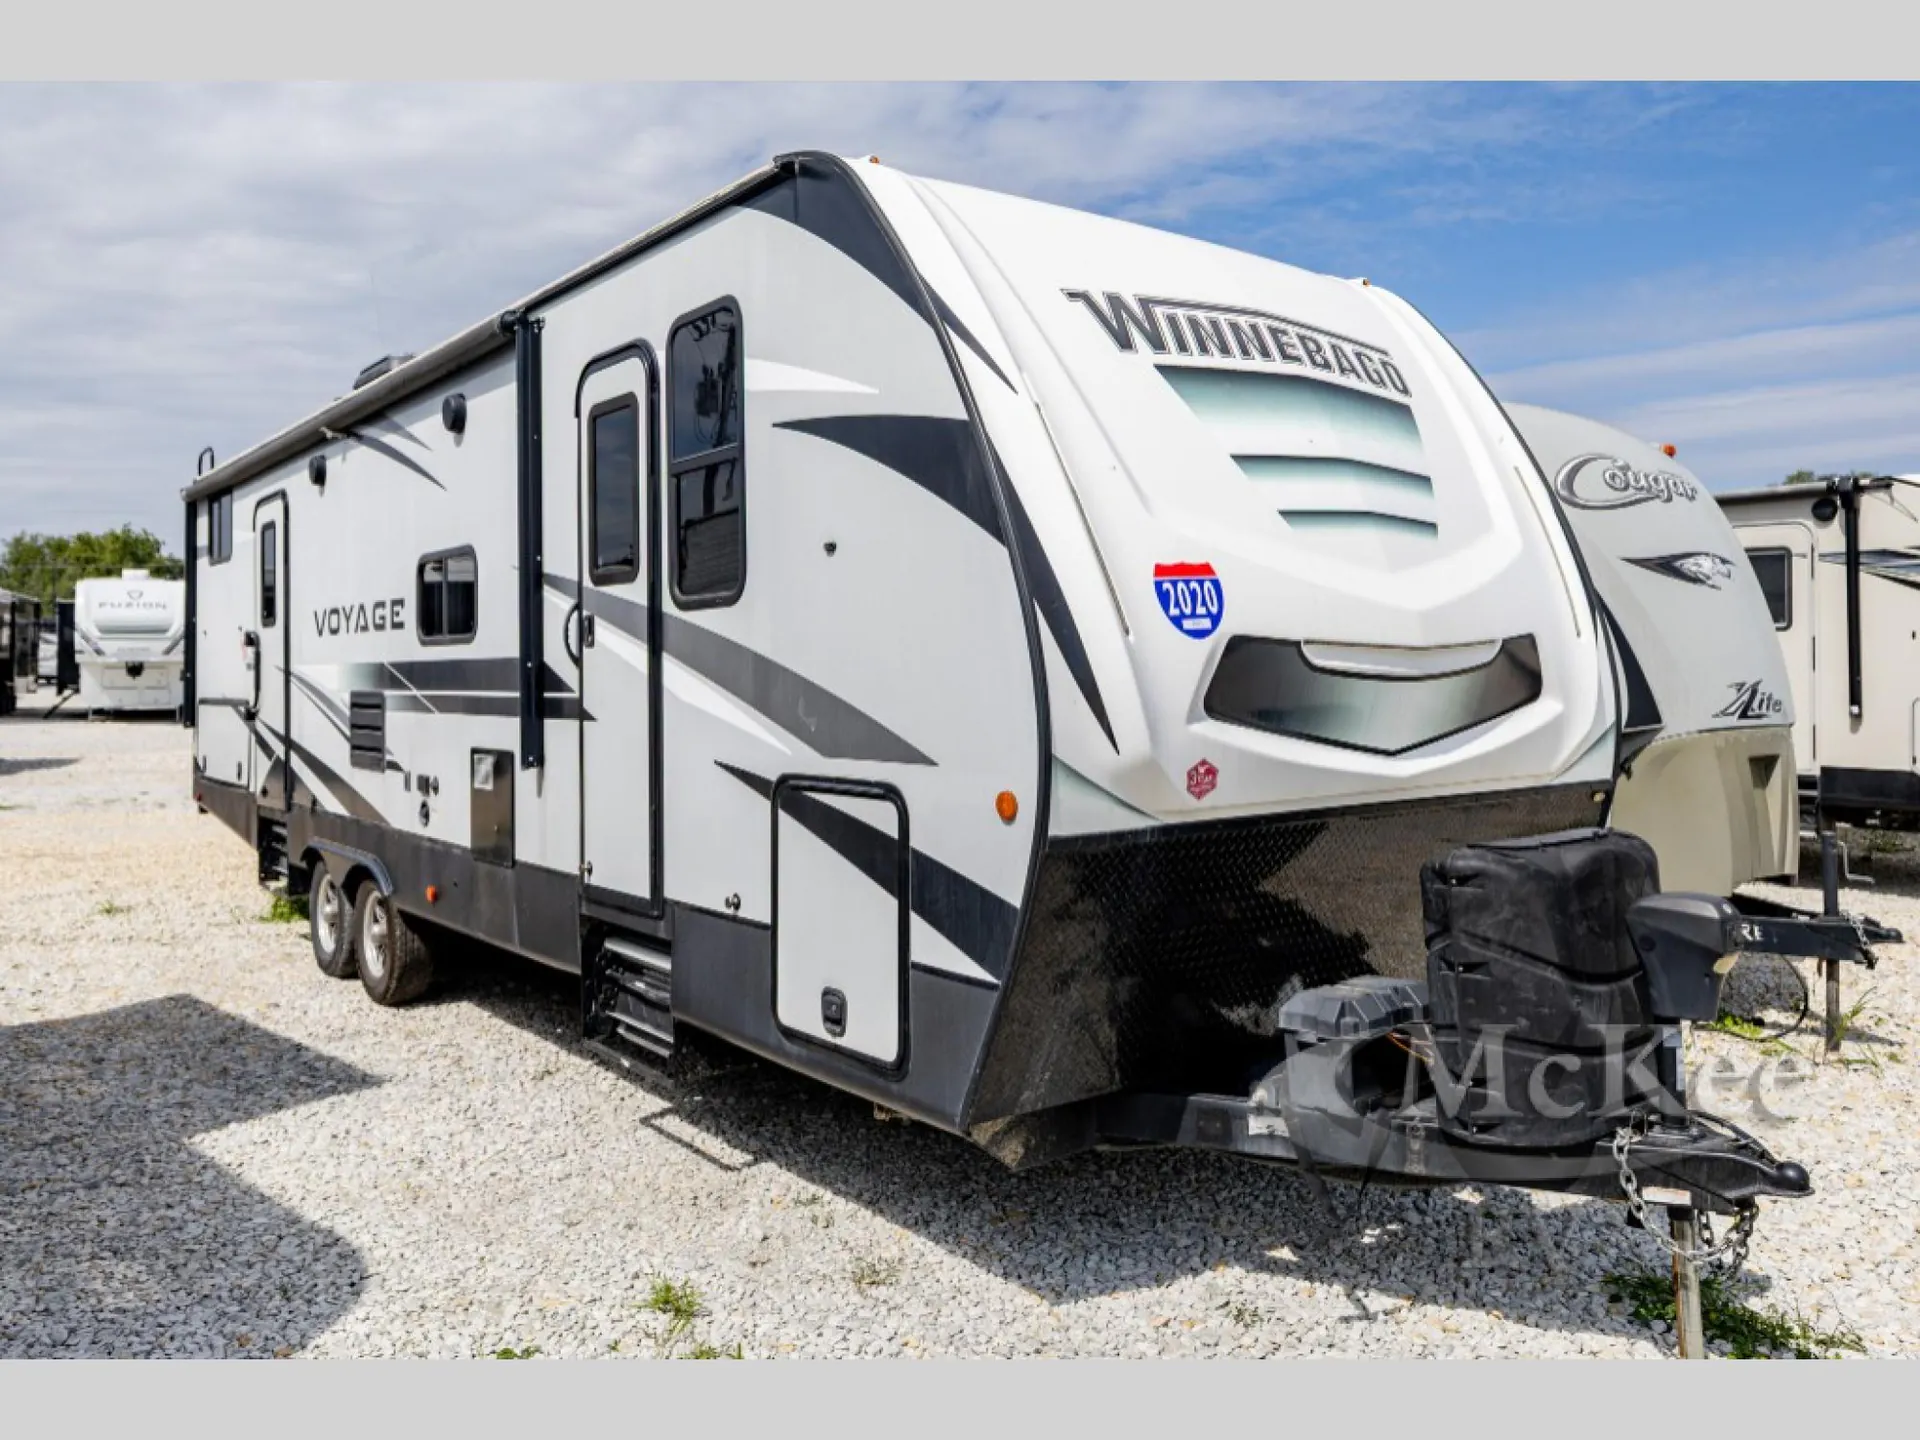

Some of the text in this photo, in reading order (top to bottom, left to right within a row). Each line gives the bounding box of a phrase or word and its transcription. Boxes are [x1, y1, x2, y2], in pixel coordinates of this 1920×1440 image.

[1060, 288, 1412, 397] WINNEBAGO
[1554, 452, 1698, 511] Cougar
[98, 601, 167, 610] FUZION
[313, 598, 405, 638] VOYAGE
[1162, 580, 1219, 616] 2020
